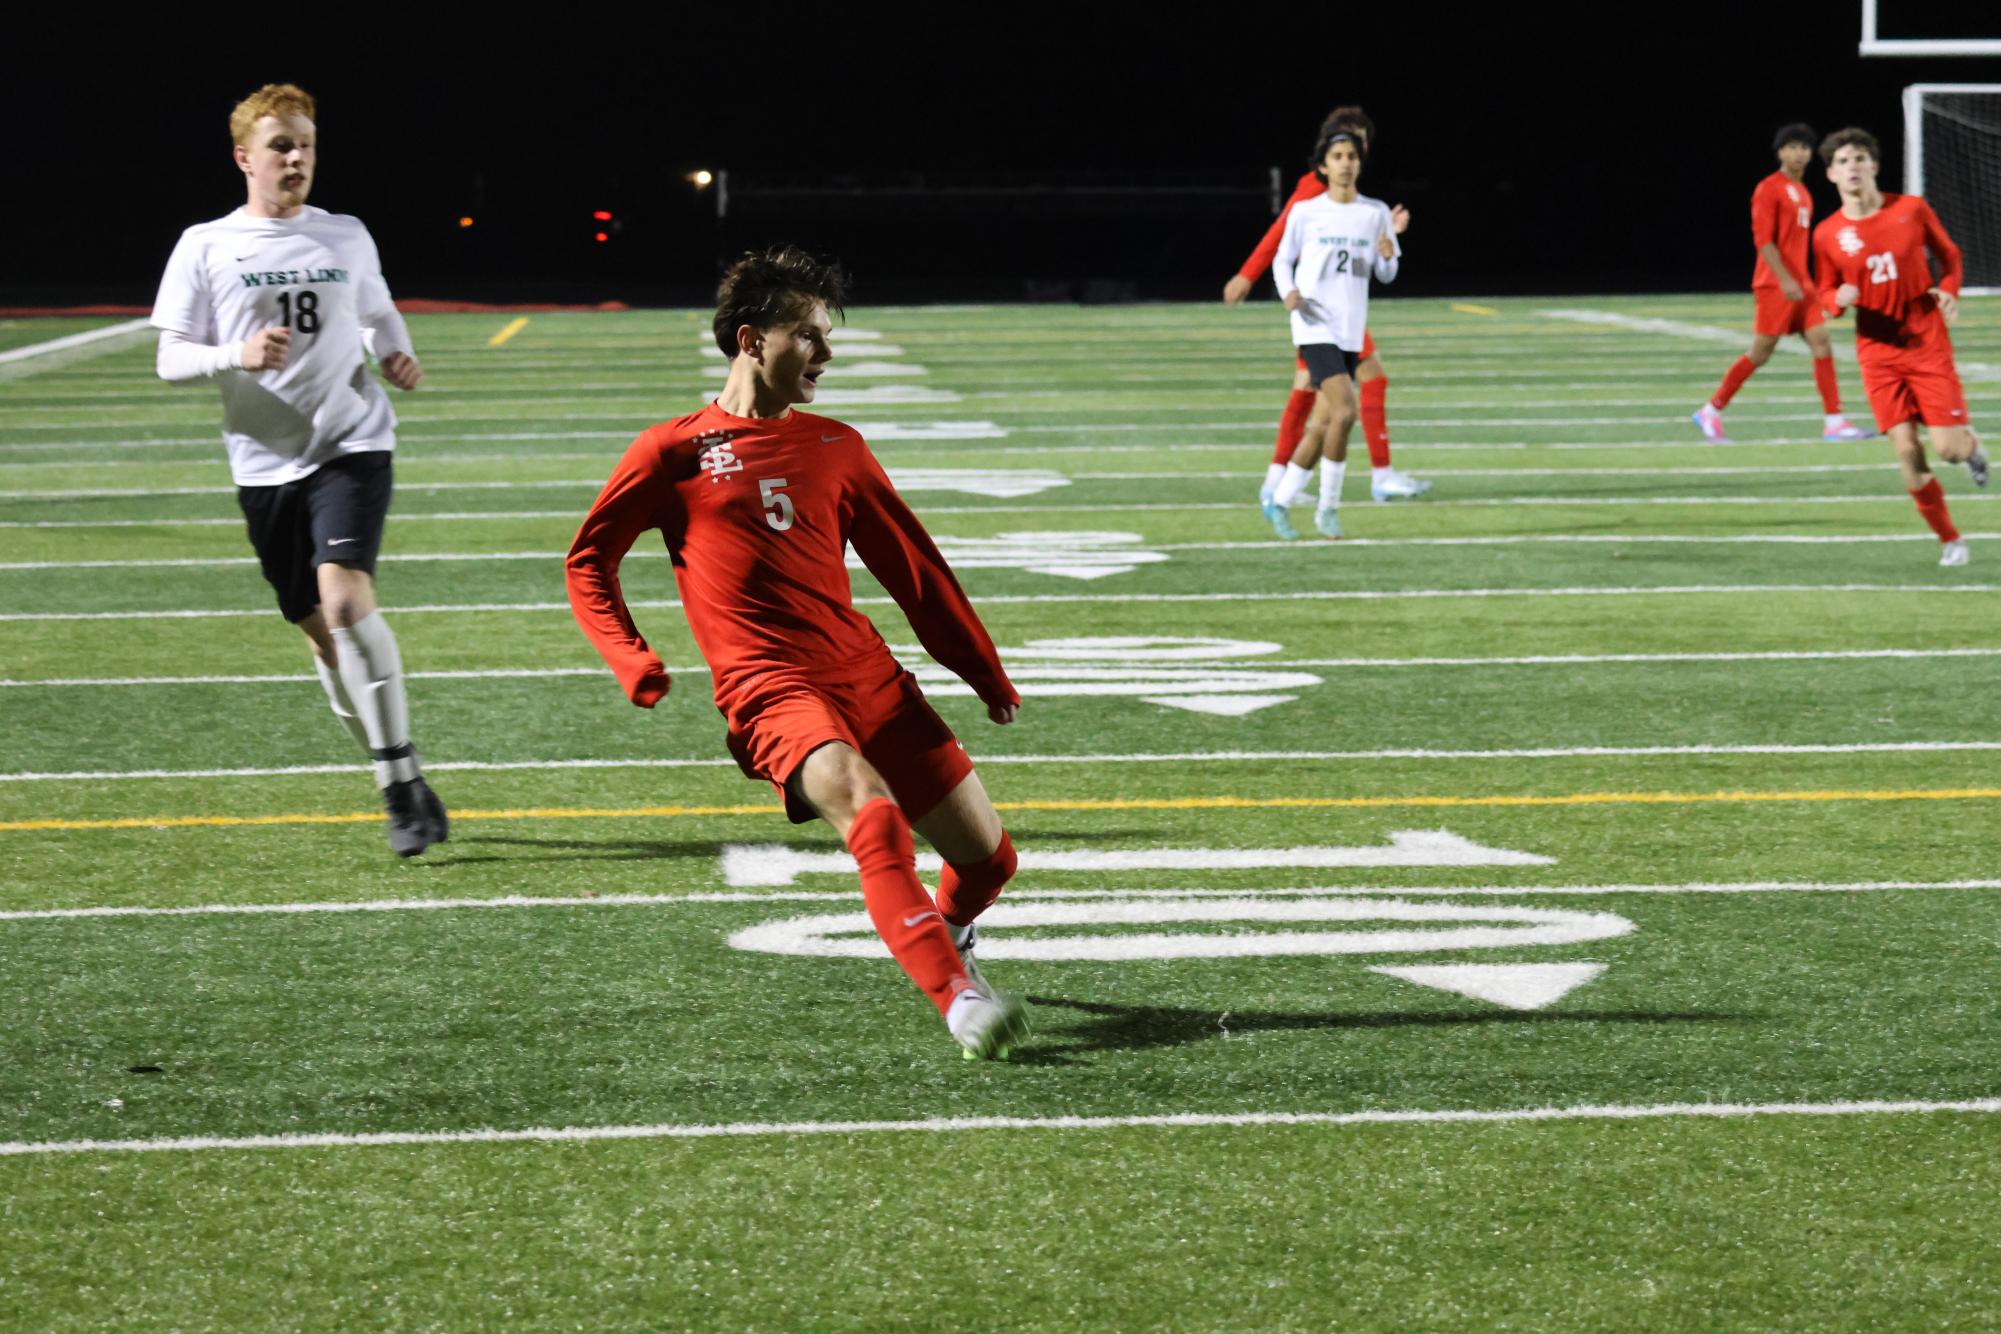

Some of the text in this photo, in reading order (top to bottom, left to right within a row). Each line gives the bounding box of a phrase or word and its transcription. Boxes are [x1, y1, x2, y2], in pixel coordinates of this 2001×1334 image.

[1336, 249, 1349, 273] 2
[1866, 251, 1898, 285] 21
[241, 270, 299, 287] WEST
[277, 291, 318, 333] 18
[758, 478, 795, 531] 5
